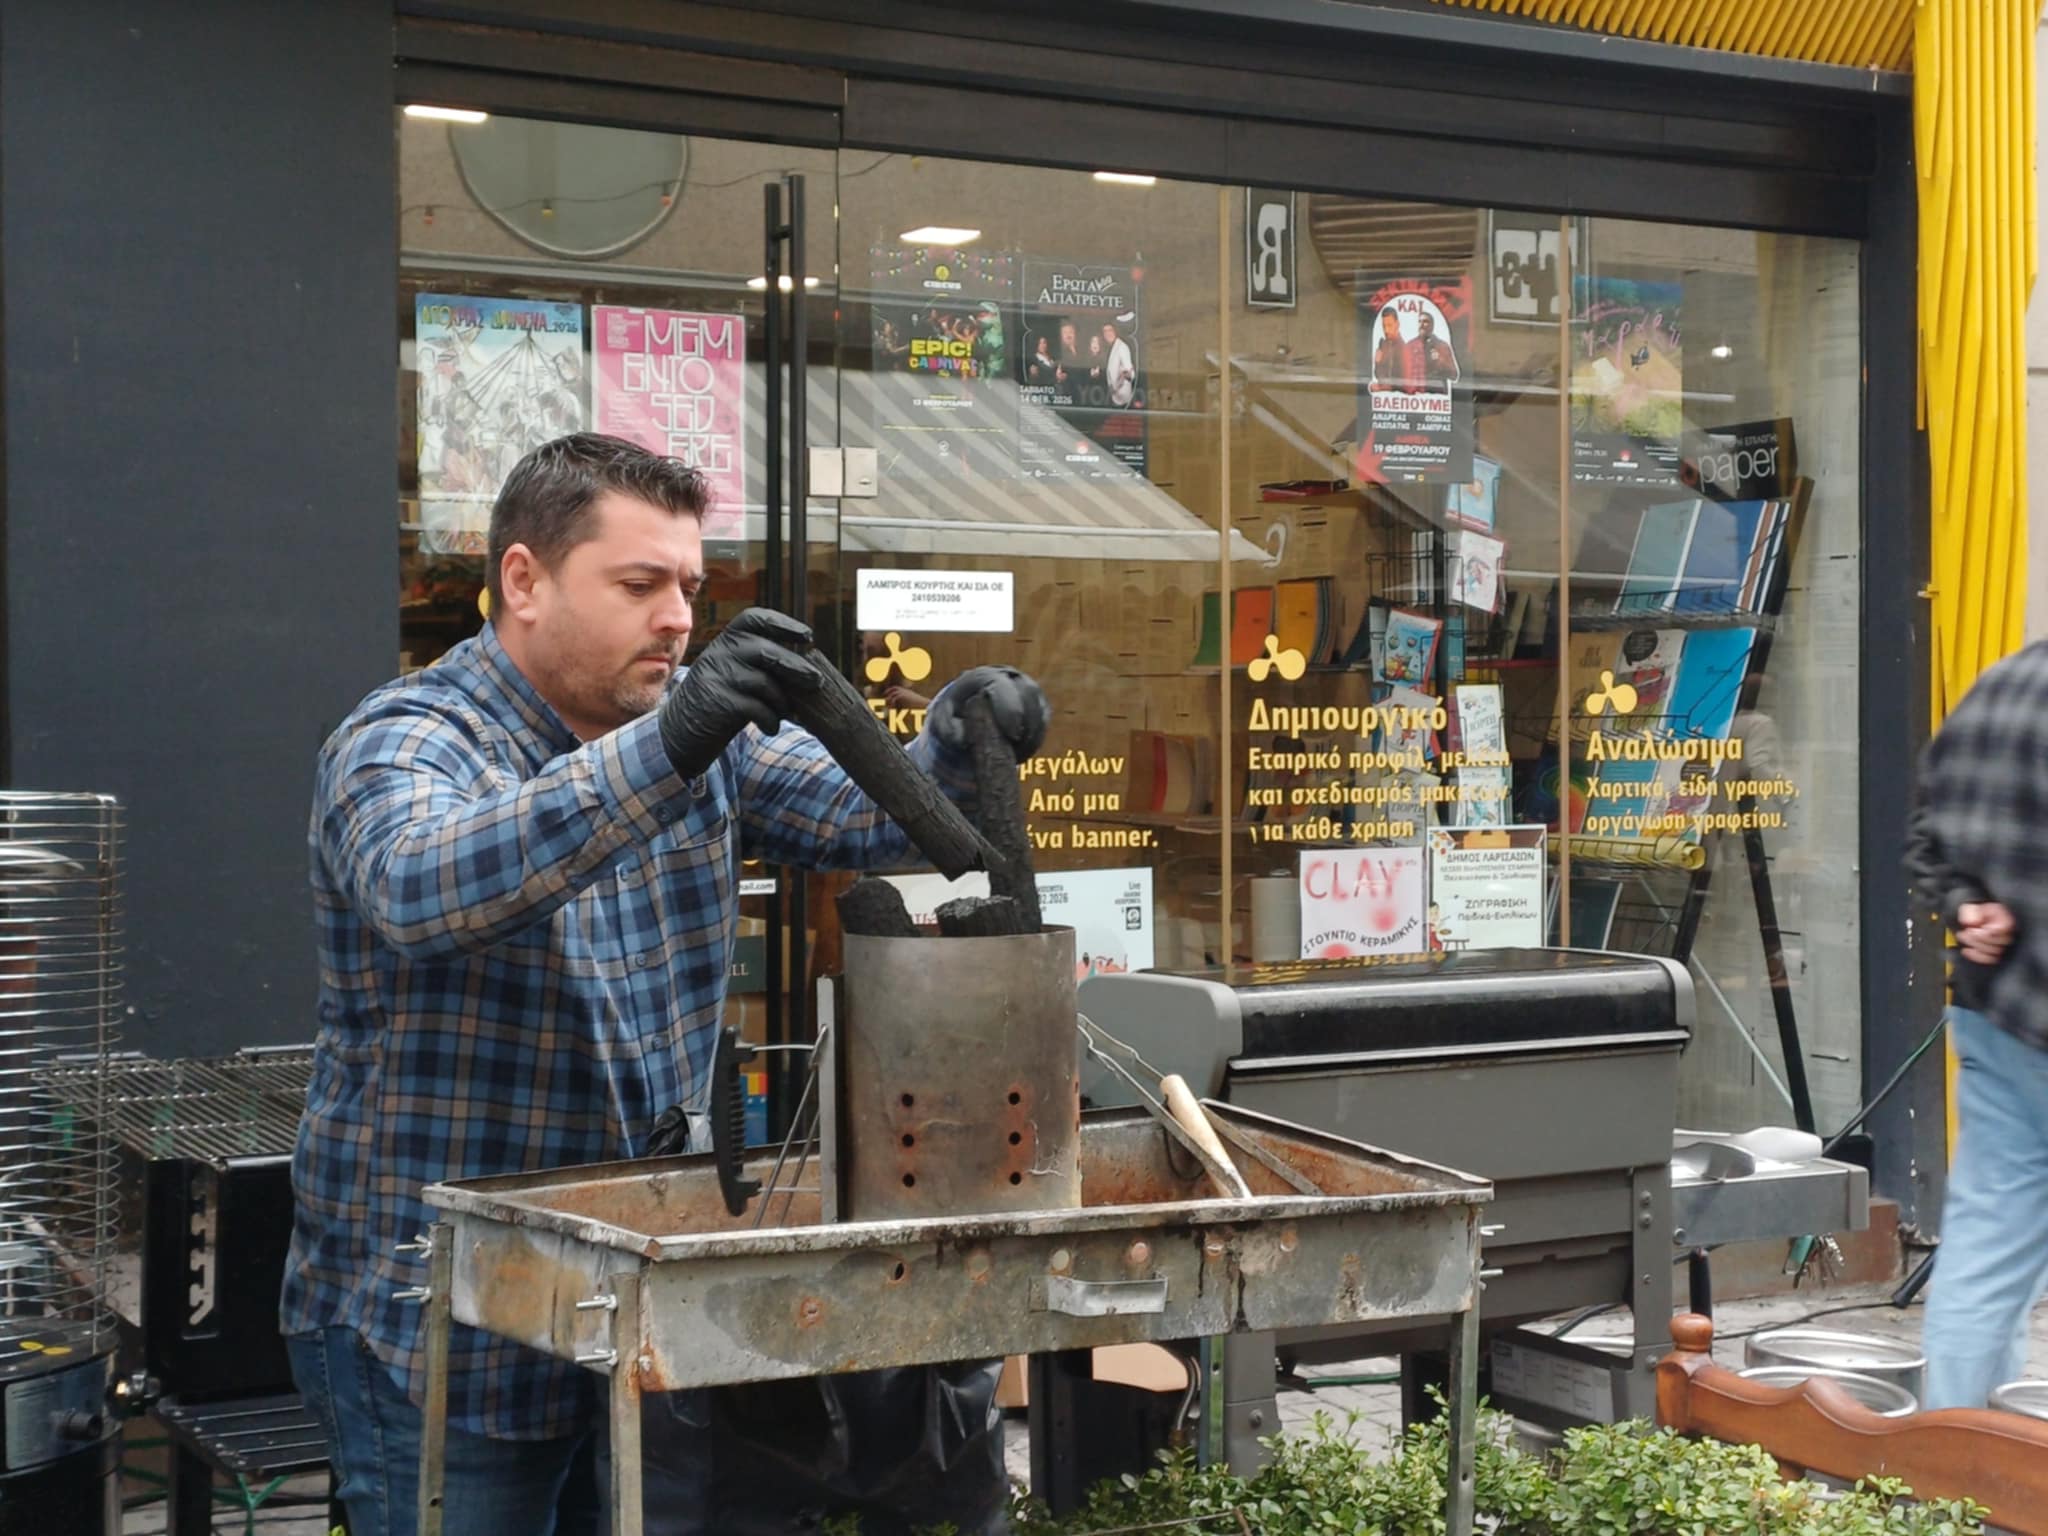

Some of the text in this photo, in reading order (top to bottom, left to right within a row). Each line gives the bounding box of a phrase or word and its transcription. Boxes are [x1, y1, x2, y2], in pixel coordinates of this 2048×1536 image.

[911, 339, 973, 358] EPIC!
[1373, 396, 1450, 412] ΒΛΕΠΟΥΜΕ
[1385, 445, 1451, 456] ΦΕΒΡΟΥΑΡΙΟΥ
[1697, 446, 1780, 493] paper
[866, 580, 913, 590] ΛΑΜΠΡΟΣ
[914, 581, 956, 591] ΚΟΥΡΤΗΣ
[957, 582, 974, 591] ΚΑΙ
[991, 582, 1005, 592] ΟΕ
[1247, 695, 1448, 739] Δημιουργικό
[1248, 744, 1342, 776] Εταιρικό
[1348, 744, 1433, 775] προφίλ,
[1585, 728, 1744, 768] Αναλώσιμα
[1018, 749, 1125, 782] μεγάλων
[1028, 787, 1120, 815] Από μια
[1248, 787, 1283, 806] και
[1290, 779, 1412, 809] σχεδιασμός
[1585, 772, 1801, 803] Χαρτικά, είδη γραφής,
[1291, 816, 1343, 840] κάθε
[1350, 814, 1414, 844] χρήση
[1585, 805, 1788, 837] οργάνωση γραφείου.
[1071, 824, 1159, 849] banner.
[1446, 852, 1481, 863] ΔΗΜΟΣ
[1303, 856, 1404, 900] CLAY
[1303, 915, 1419, 955] ΣΤΟΥΝΤΙΟ ΚΕΡΑΜΙΚΗΣ
